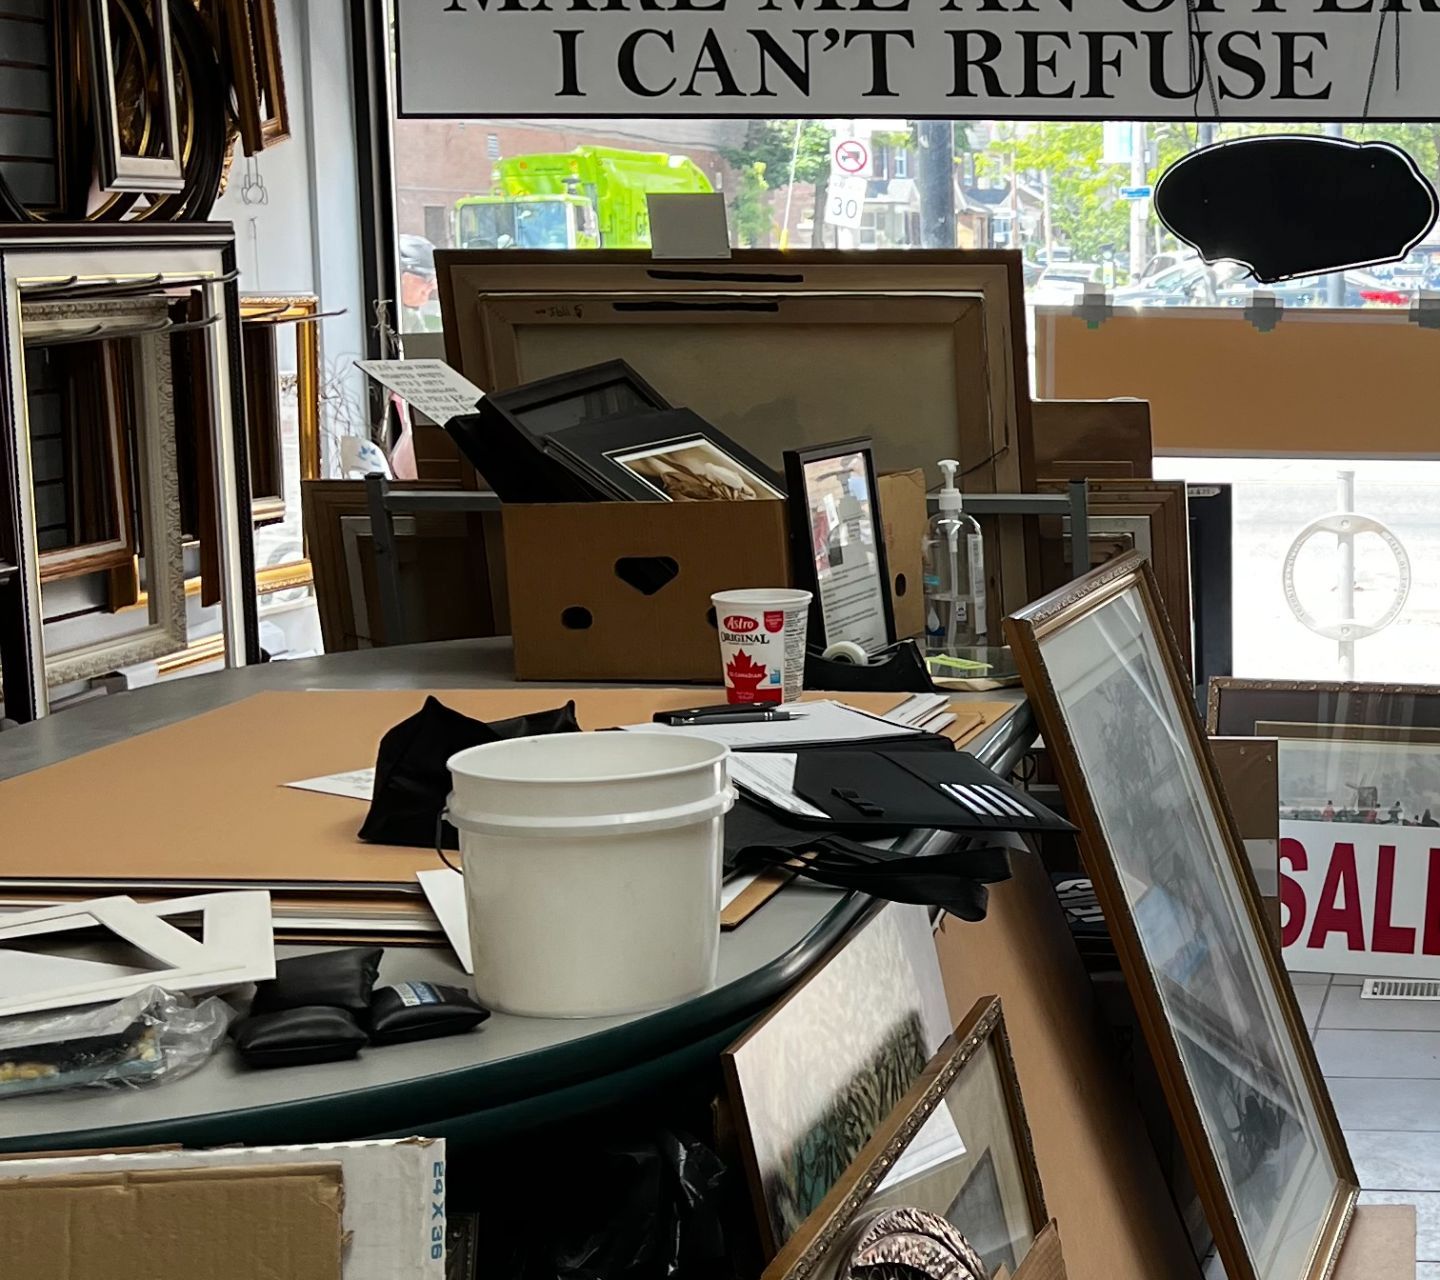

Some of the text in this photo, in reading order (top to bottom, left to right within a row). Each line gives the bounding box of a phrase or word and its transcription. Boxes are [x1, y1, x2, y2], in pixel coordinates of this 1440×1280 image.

[553, 27, 1332, 100] I CAN'T REFUSE
[832, 196, 858, 219] 30
[726, 616, 755, 630] Astro
[720, 631, 770, 645] ORIGINAL
[430, 1225, 443, 1260] 36
